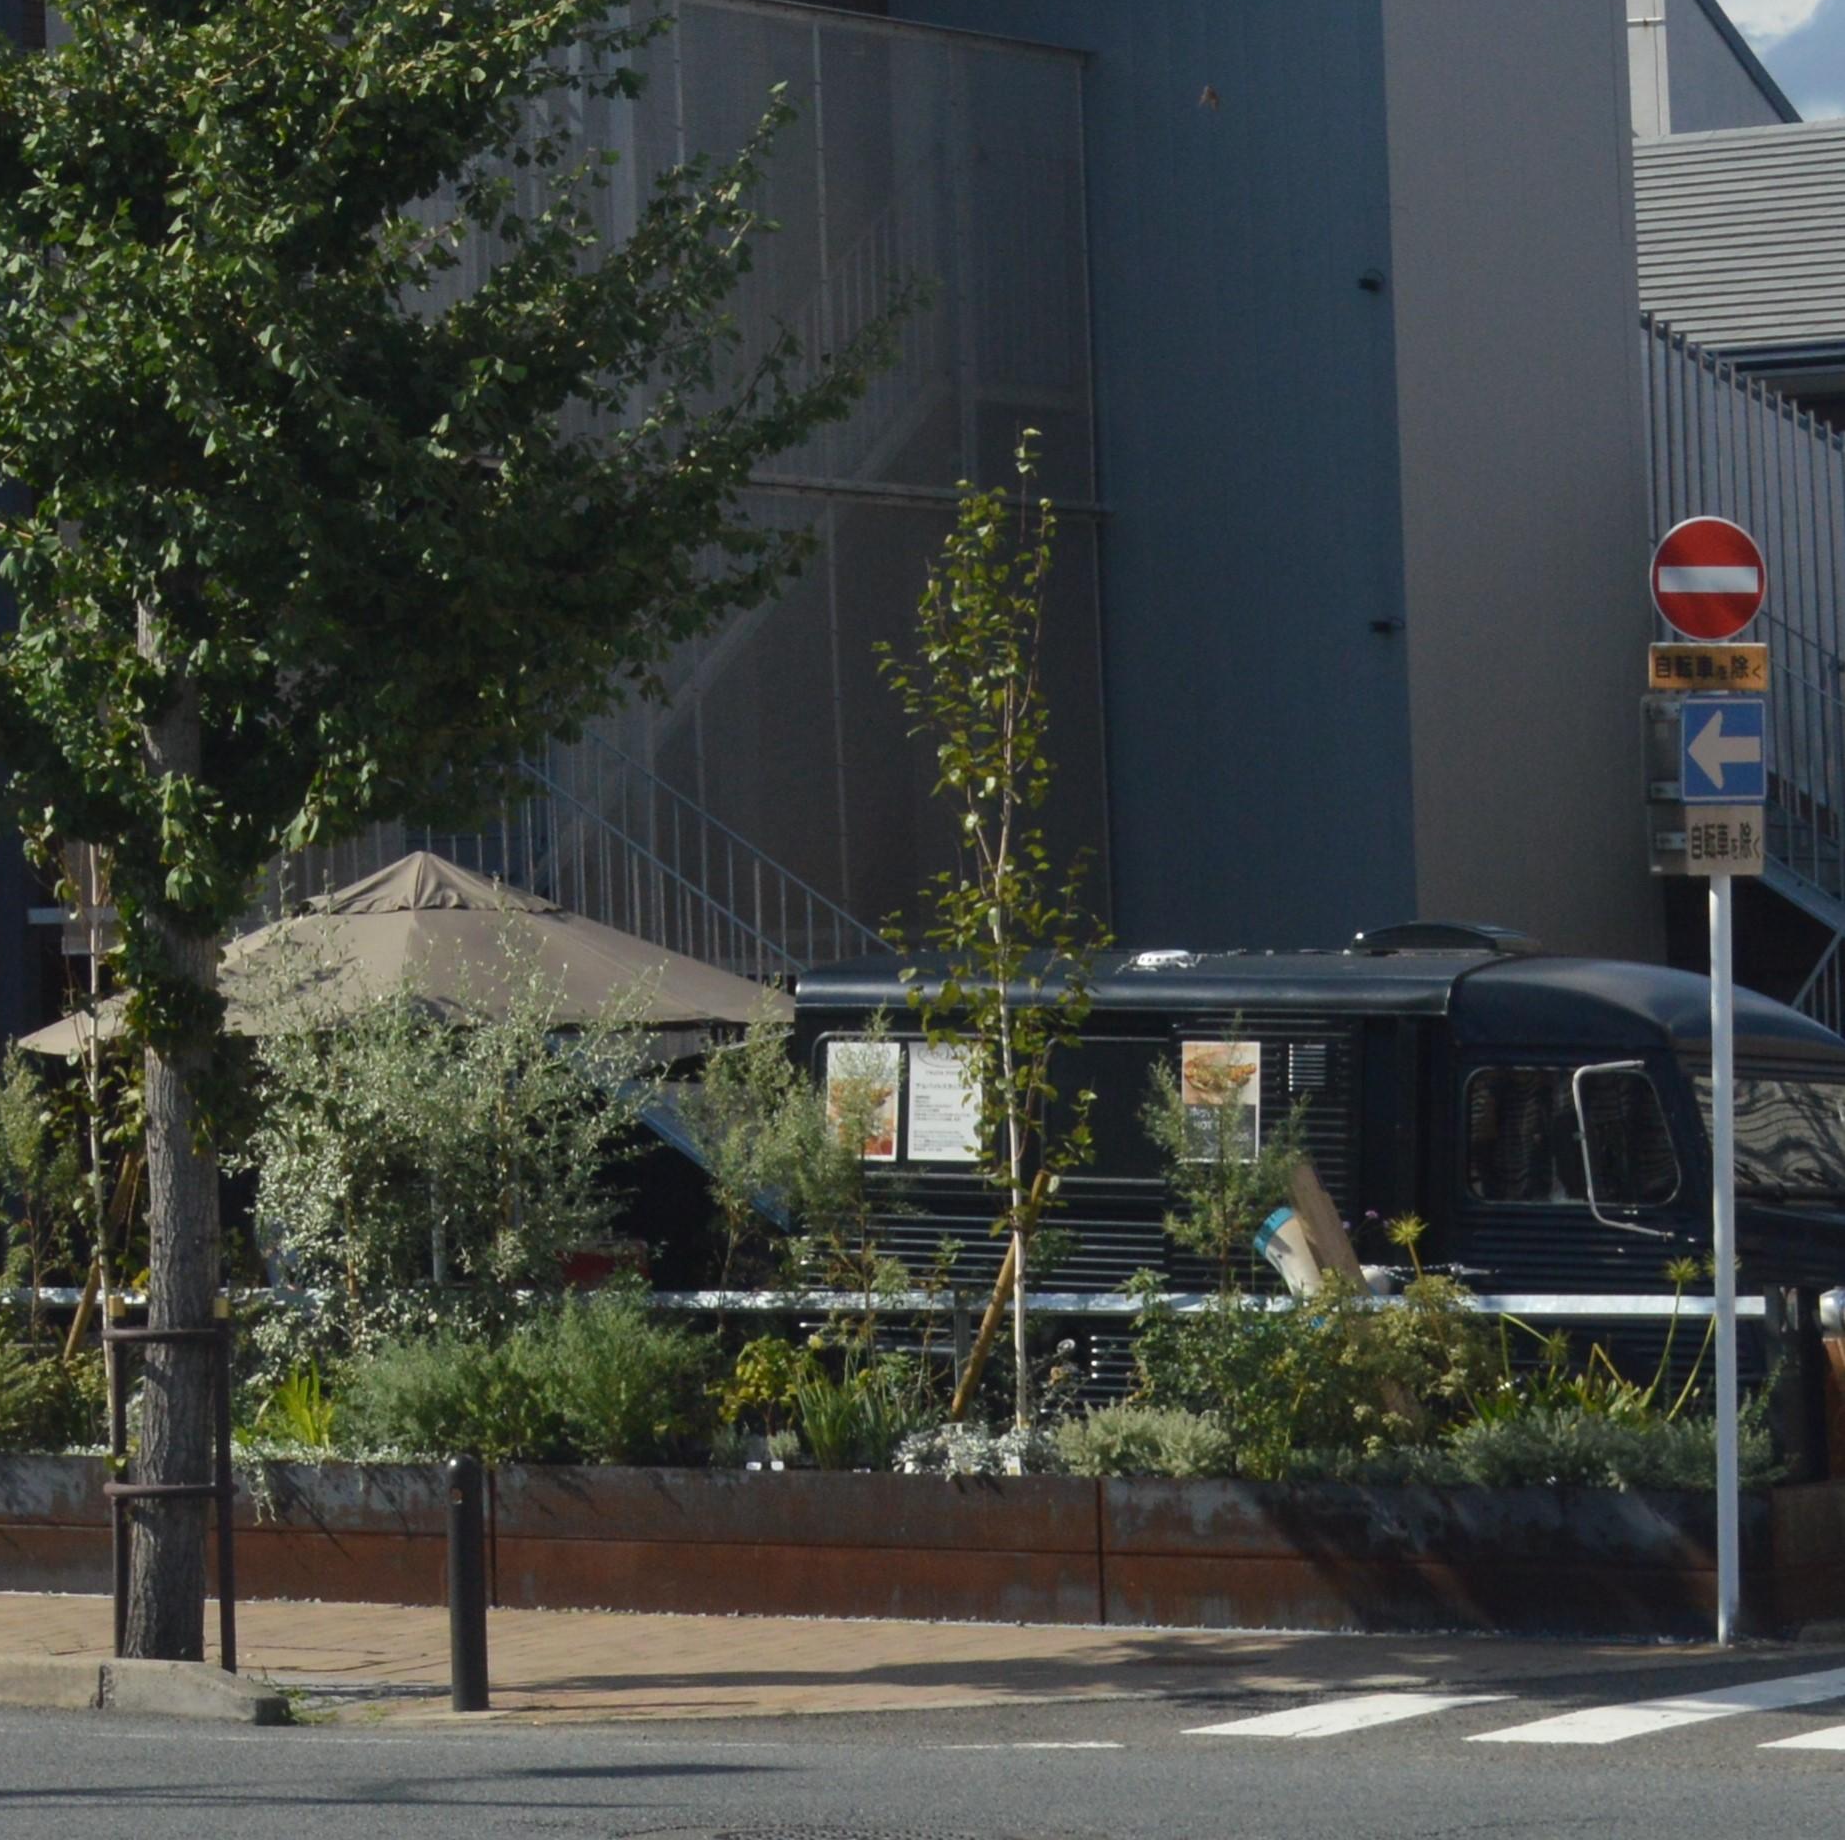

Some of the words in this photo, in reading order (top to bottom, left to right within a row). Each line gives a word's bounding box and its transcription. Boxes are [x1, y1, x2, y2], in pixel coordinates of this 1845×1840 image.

[1655, 655, 1762, 681] 自転車を除く
